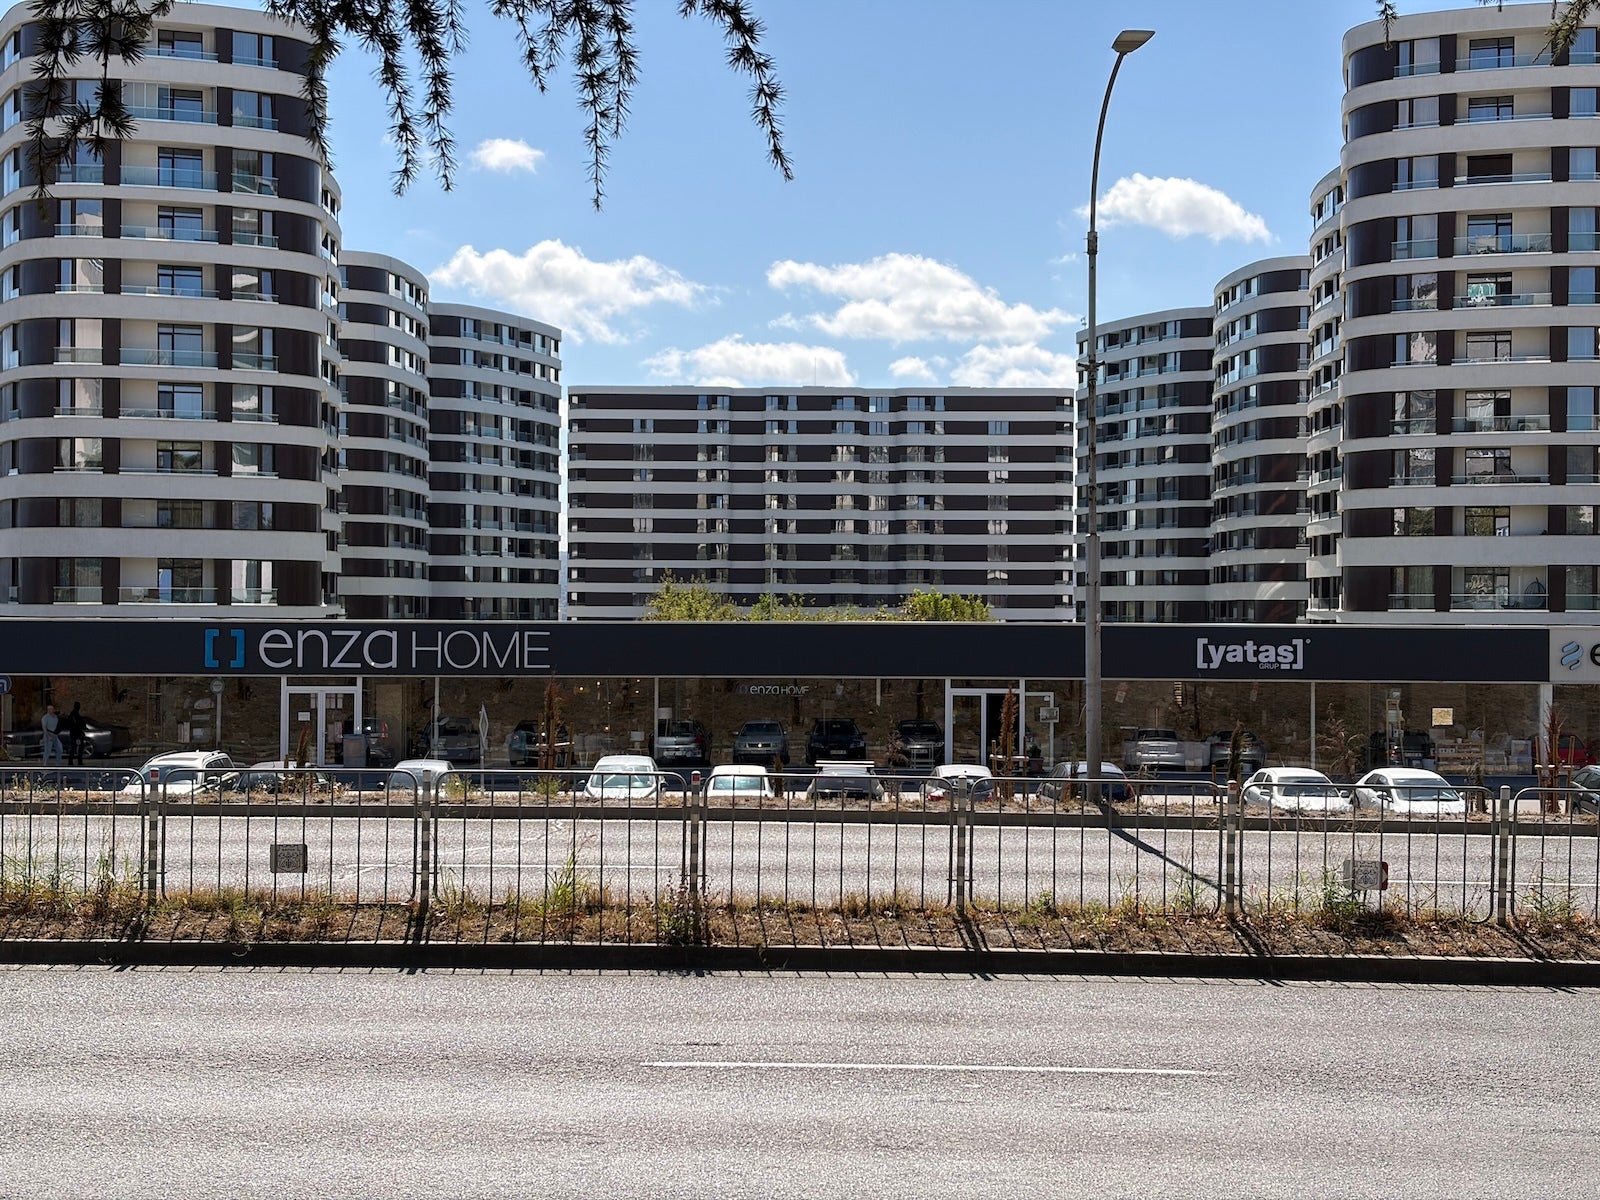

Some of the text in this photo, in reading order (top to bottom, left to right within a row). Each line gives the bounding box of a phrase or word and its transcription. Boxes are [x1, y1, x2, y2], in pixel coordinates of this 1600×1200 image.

[258, 629, 551, 669] enza HOME
[749, 685, 809, 695] enza HOME
